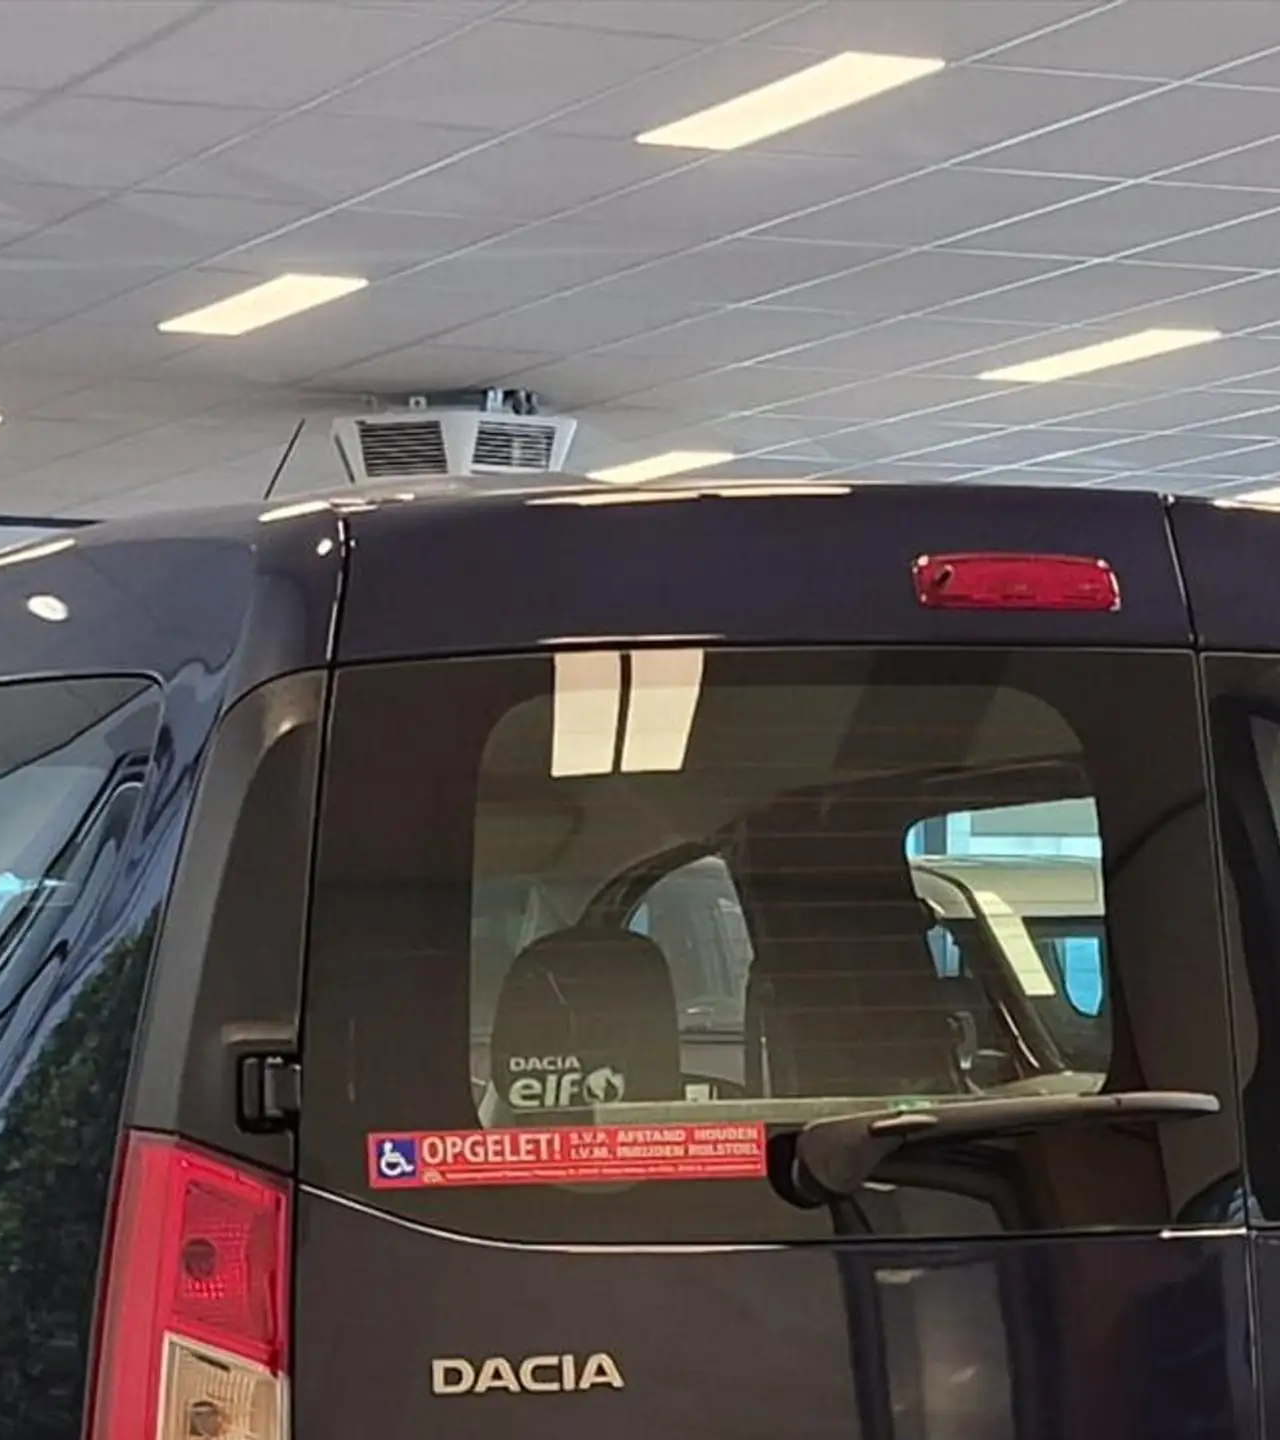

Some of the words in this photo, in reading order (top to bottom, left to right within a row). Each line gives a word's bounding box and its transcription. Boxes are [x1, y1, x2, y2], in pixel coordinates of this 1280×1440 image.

[509, 1055, 581, 1071] DACIA
[508, 1072, 583, 1107] elf
[422, 1133, 561, 1164] OPGELET!
[432, 1352, 625, 1394] DACIA
